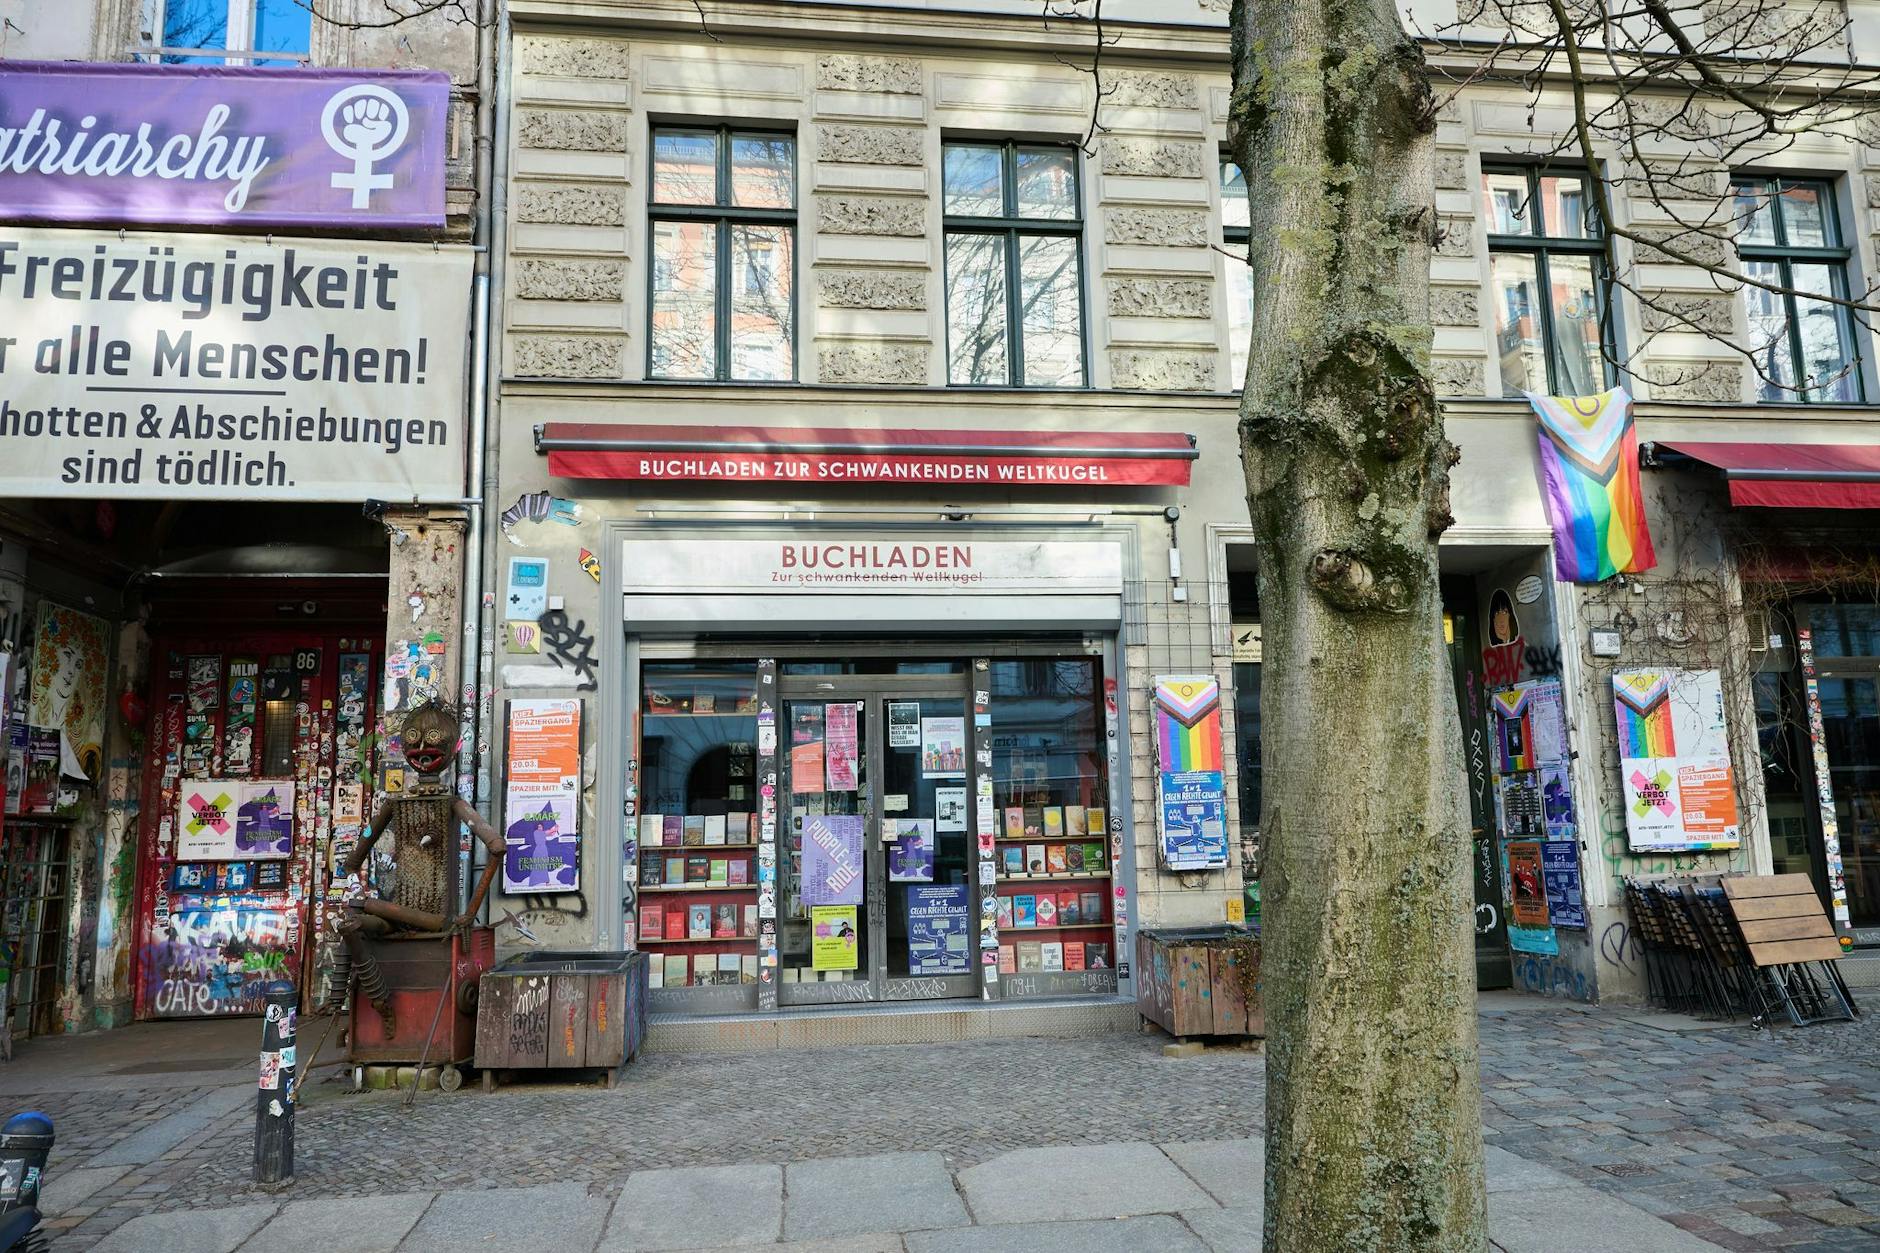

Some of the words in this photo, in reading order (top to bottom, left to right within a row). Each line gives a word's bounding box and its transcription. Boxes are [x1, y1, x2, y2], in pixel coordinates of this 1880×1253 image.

[0, 240, 398, 322] Freizügigkeit
[34, 325, 131, 376] alle
[153, 329, 428, 385] Menschen!
[136, 403, 163, 439] &
[169, 403, 447, 455] Abschiebungen
[61, 448, 142, 485] sind
[156, 449, 295, 487] tödlich.
[639, 459, 765, 477] BUCHLADEN
[774, 461, 810, 477] ZUR
[818, 461, 989, 480] SCHWANKENDEN
[997, 464, 1108, 482] WELTKUGEL
[782, 545, 972, 569] BUCHLADEN
[772, 571, 792, 583] Zur
[798, 571, 907, 583] schwankenden
[913, 571, 983, 585] Weltkugel
[296, 652, 316, 670] 86
[230, 663, 259, 677] MLM
[1636, 791, 1669, 799] VERBOT
[1644, 783, 1660, 791] AFD
[1182, 791, 1201, 801] RECHTE
[1201, 790, 1221, 799] GEWALT
[191, 811, 227, 819] VERBOT
[200, 804, 219, 812] AFD
[195, 818, 221, 826] JETZT
[806, 819, 851, 865] PURPLE
[825, 860, 860, 894] RIDE
[927, 905, 948, 914] RECHTE
[948, 905, 967, 913] GEWALT
